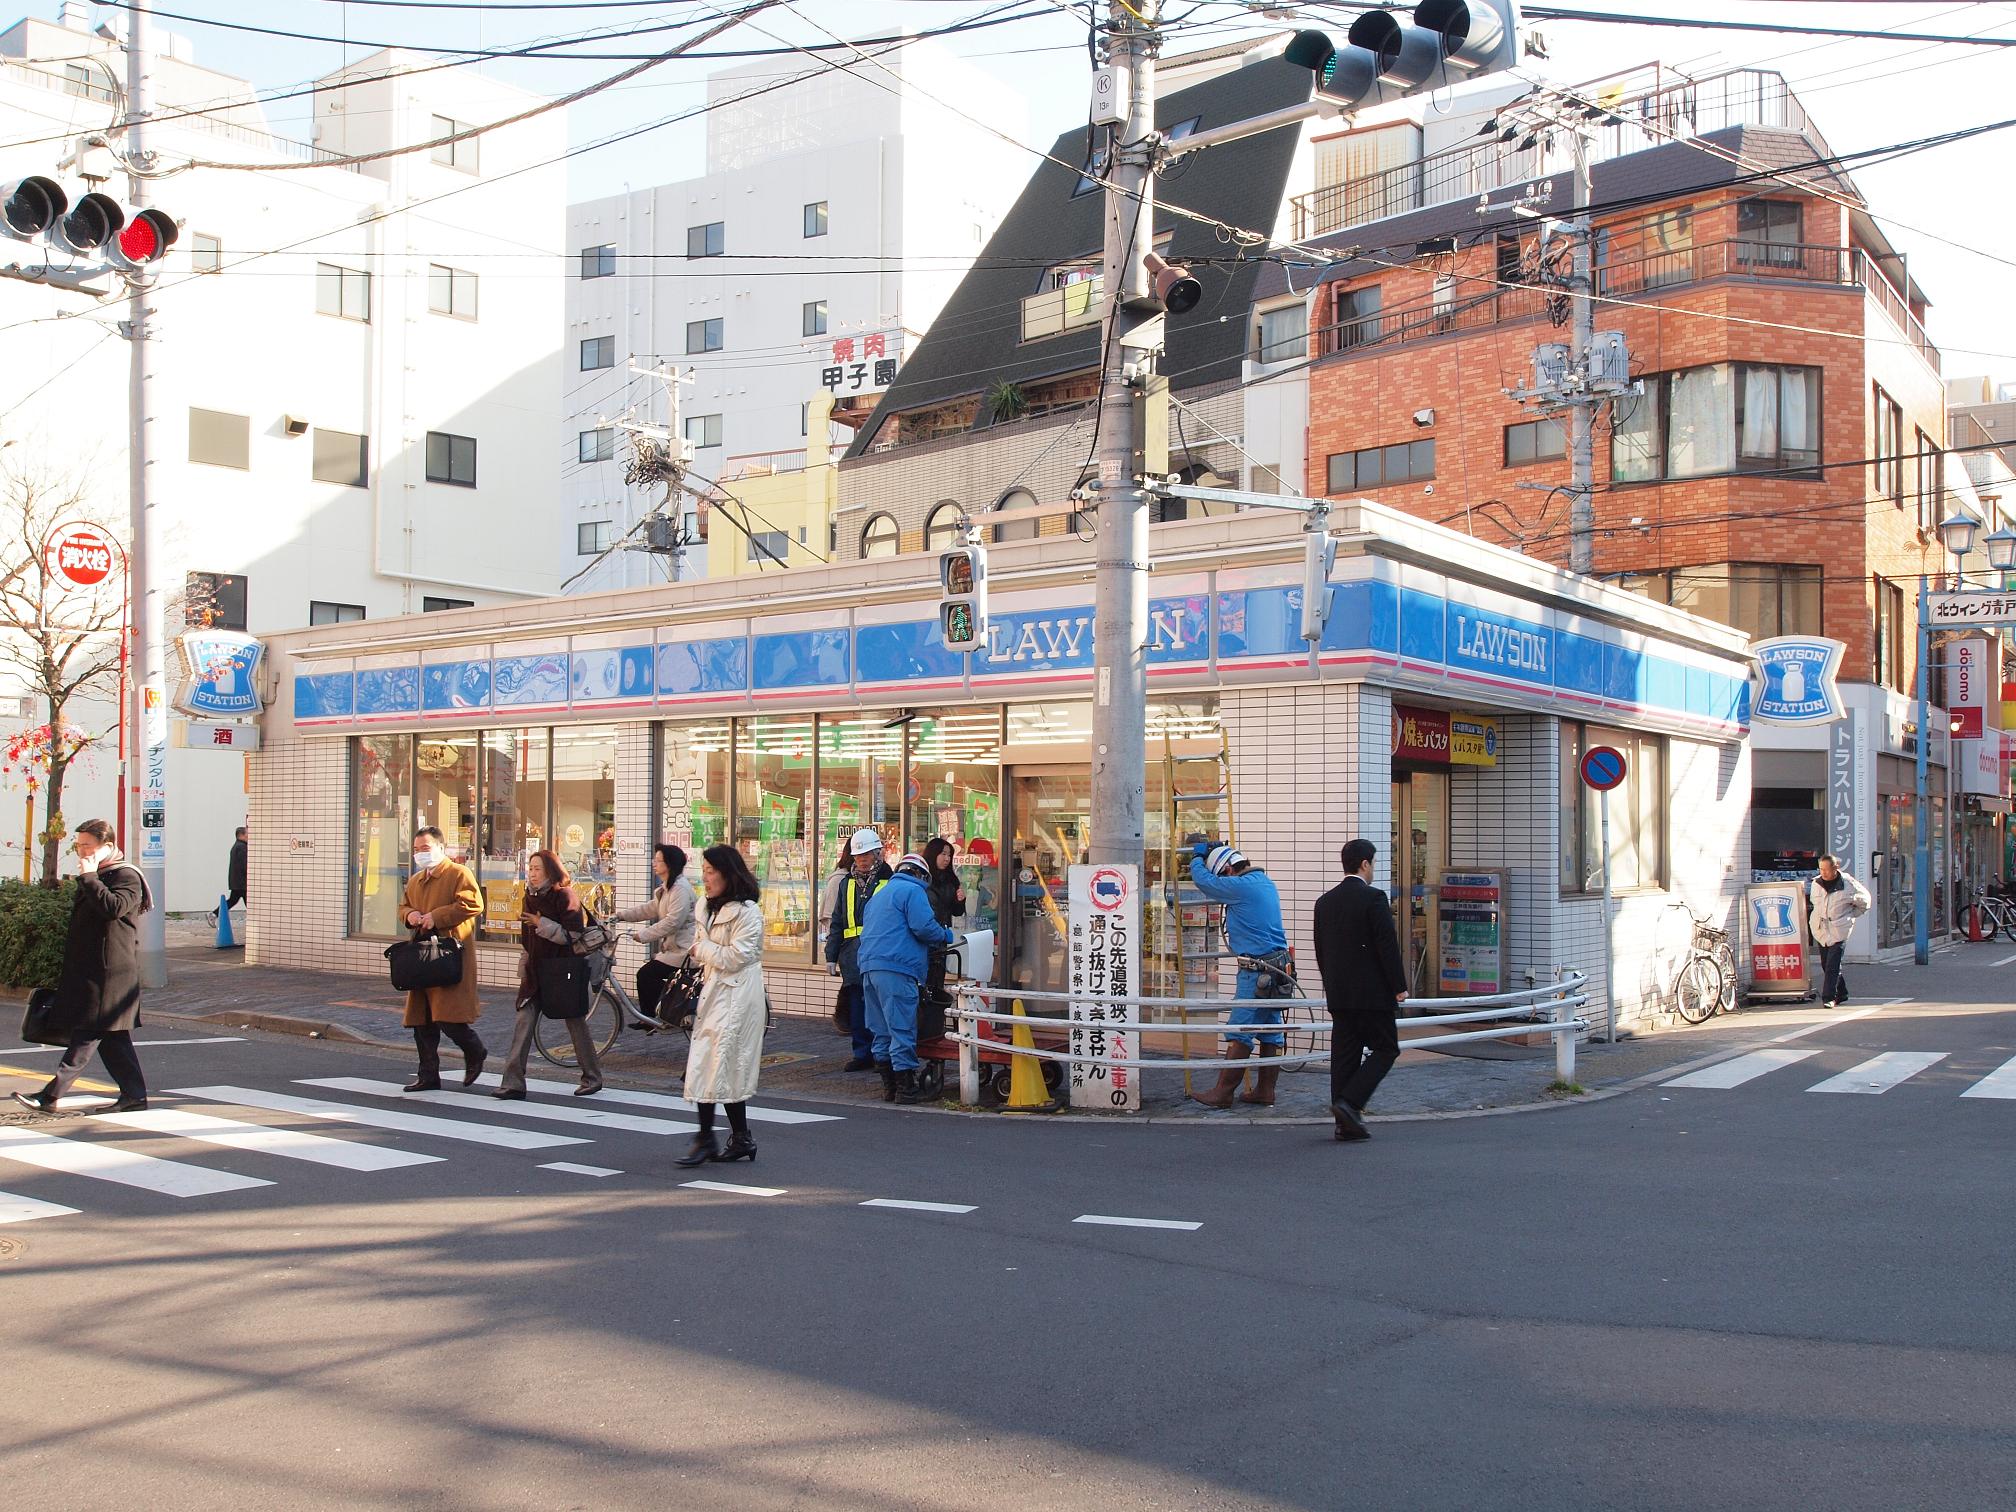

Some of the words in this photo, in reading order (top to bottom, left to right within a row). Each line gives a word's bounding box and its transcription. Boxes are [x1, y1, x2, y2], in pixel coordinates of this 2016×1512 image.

[833, 333, 886, 364] 焼肉
[822, 358, 897, 393] 甲子園
[61, 545, 110, 572] 消火栓
[1937, 598, 2016, 618] 北ウイング青戸
[987, 608, 1186, 664] LAWN
[1457, 615, 1547, 672] LAWSON
[1762, 649, 1825, 663] LAWSON
[1959, 647, 1973, 702] docomo
[198, 692, 253, 707] STATION
[1762, 699, 1825, 714] STATION
[213, 728, 233, 745] 酒
[1404, 716, 1448, 750] 焼きパスタ
[1755, 898, 1790, 907] LAWSON
[1756, 925, 1793, 935] STATION
[1754, 954, 1800, 970] 営業中
